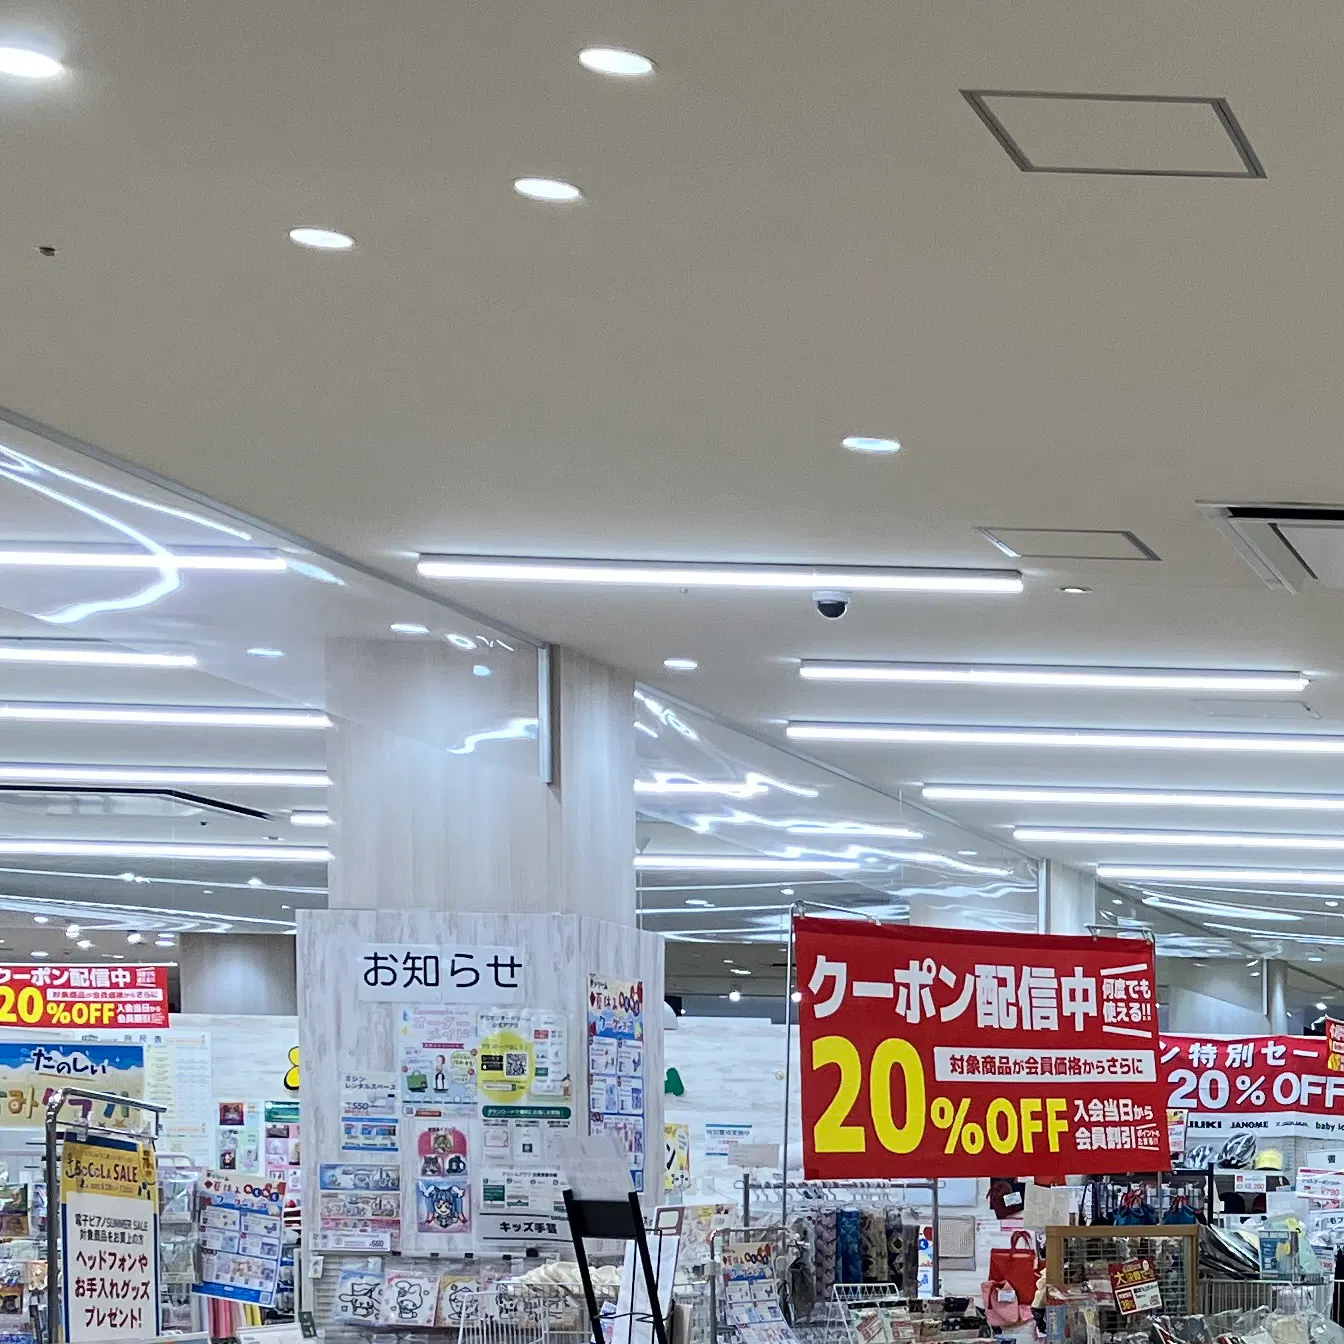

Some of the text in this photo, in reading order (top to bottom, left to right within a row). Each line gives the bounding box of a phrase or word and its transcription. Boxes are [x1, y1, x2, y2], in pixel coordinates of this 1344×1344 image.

[0, 967, 131, 988] クーポン配信中
[363, 951, 523, 988] お知らせ
[807, 954, 1098, 1032] クーポン配信中
[1102, 978, 1151, 1000] 何度でも
[33, 1048, 107, 1076] たのしい
[949, 1054, 1144, 1077] 対象商品が会員価格からさらに
[1074, 1098, 1154, 1122] 入会当日から
[1075, 1125, 1137, 1151] 会員割引
[1187, 1120, 1222, 1129] JUKI
[1230, 1120, 1269, 1129] JANOME
[1315, 1121, 1336, 1132] baby
[113, 1163, 138, 1184] SALE
[76, 1250, 149, 1274] ヘッドフォンや
[75, 1277, 151, 1301] お手入れグッズ
